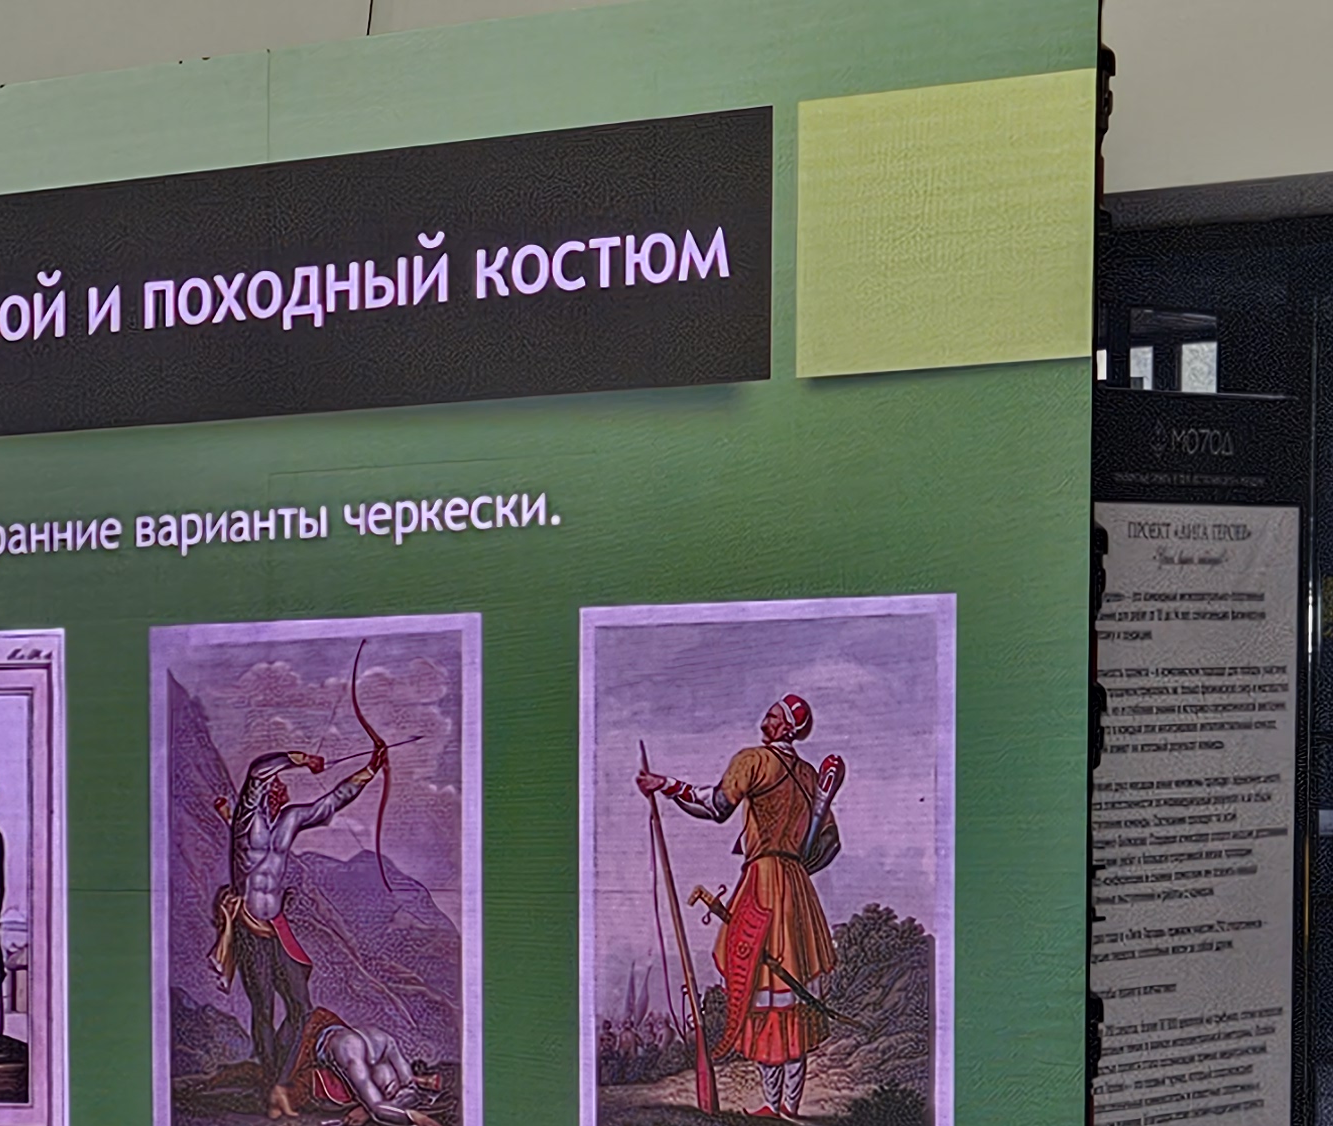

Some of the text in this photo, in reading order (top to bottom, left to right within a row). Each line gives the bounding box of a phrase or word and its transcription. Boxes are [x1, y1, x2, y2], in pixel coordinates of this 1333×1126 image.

[87, 284, 122, 336] и
[143, 230, 449, 331] походный
[475, 226, 731, 299] костюм
[134, 505, 329, 557] варианты
[342, 492, 562, 546] черкески.
